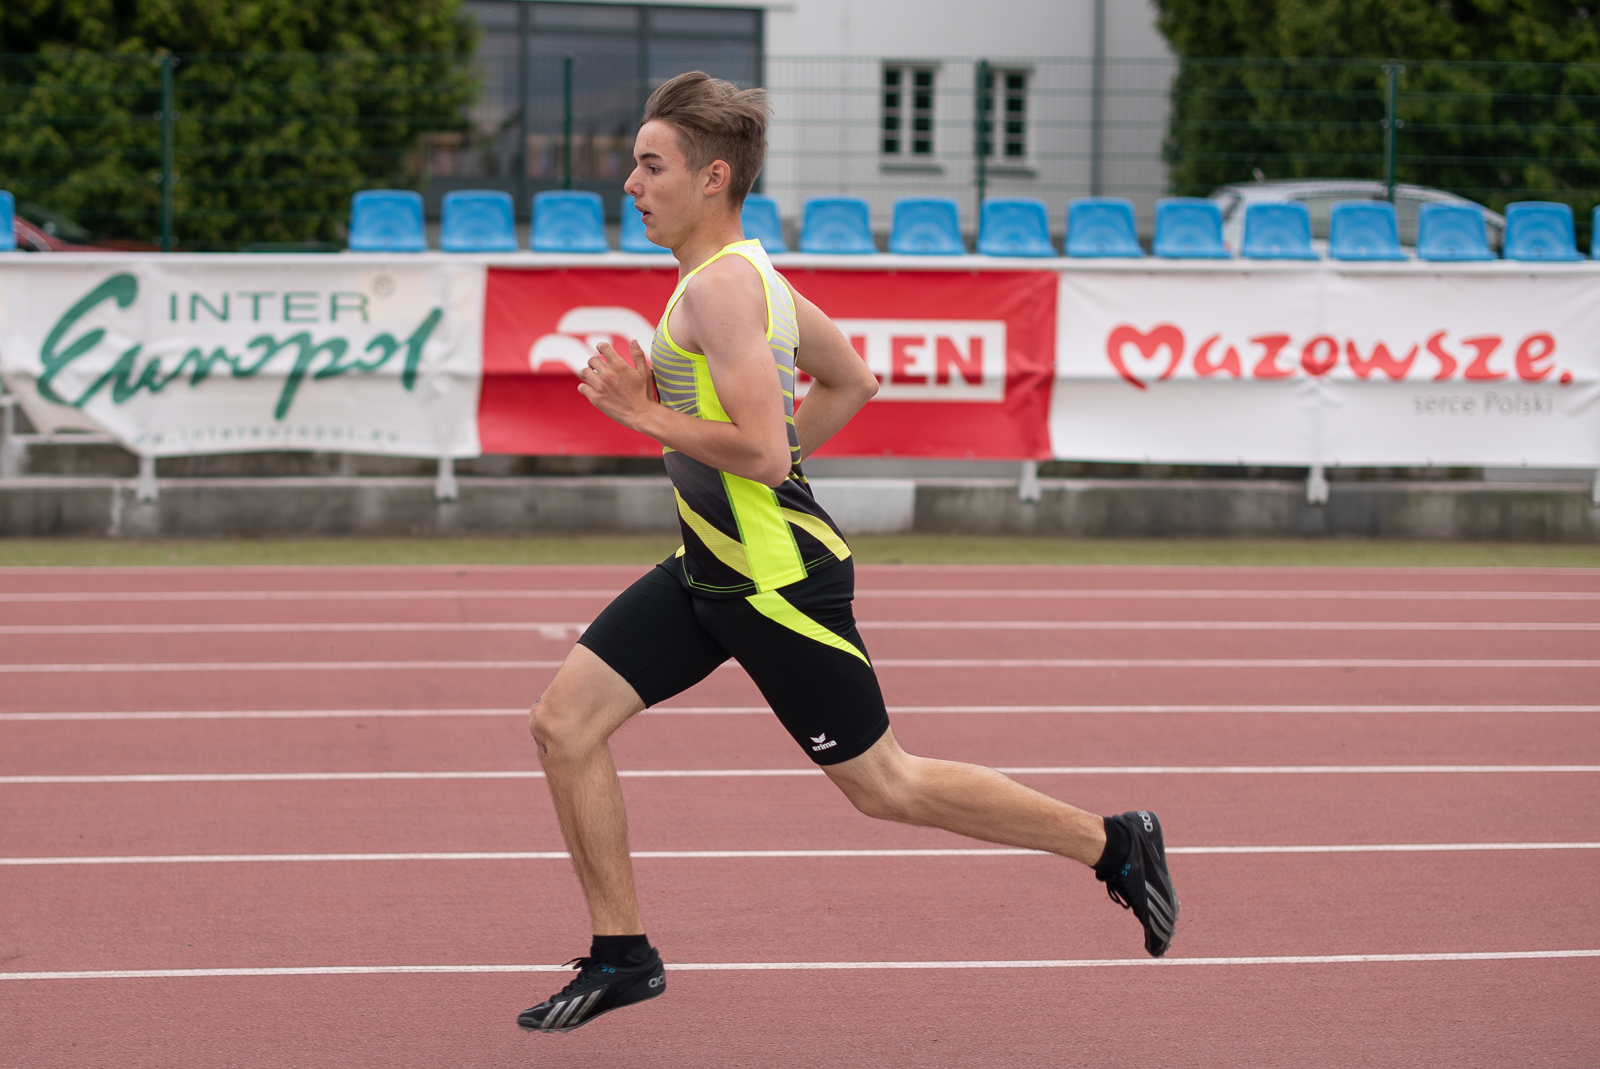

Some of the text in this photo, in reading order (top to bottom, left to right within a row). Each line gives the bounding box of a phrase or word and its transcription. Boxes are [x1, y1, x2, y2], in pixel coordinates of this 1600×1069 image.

[169, 291, 370, 322] INTER
[38, 272, 442, 420] Europol
[1412, 390, 1554, 416] serce Polski
[812, 740, 837, 751] erima
